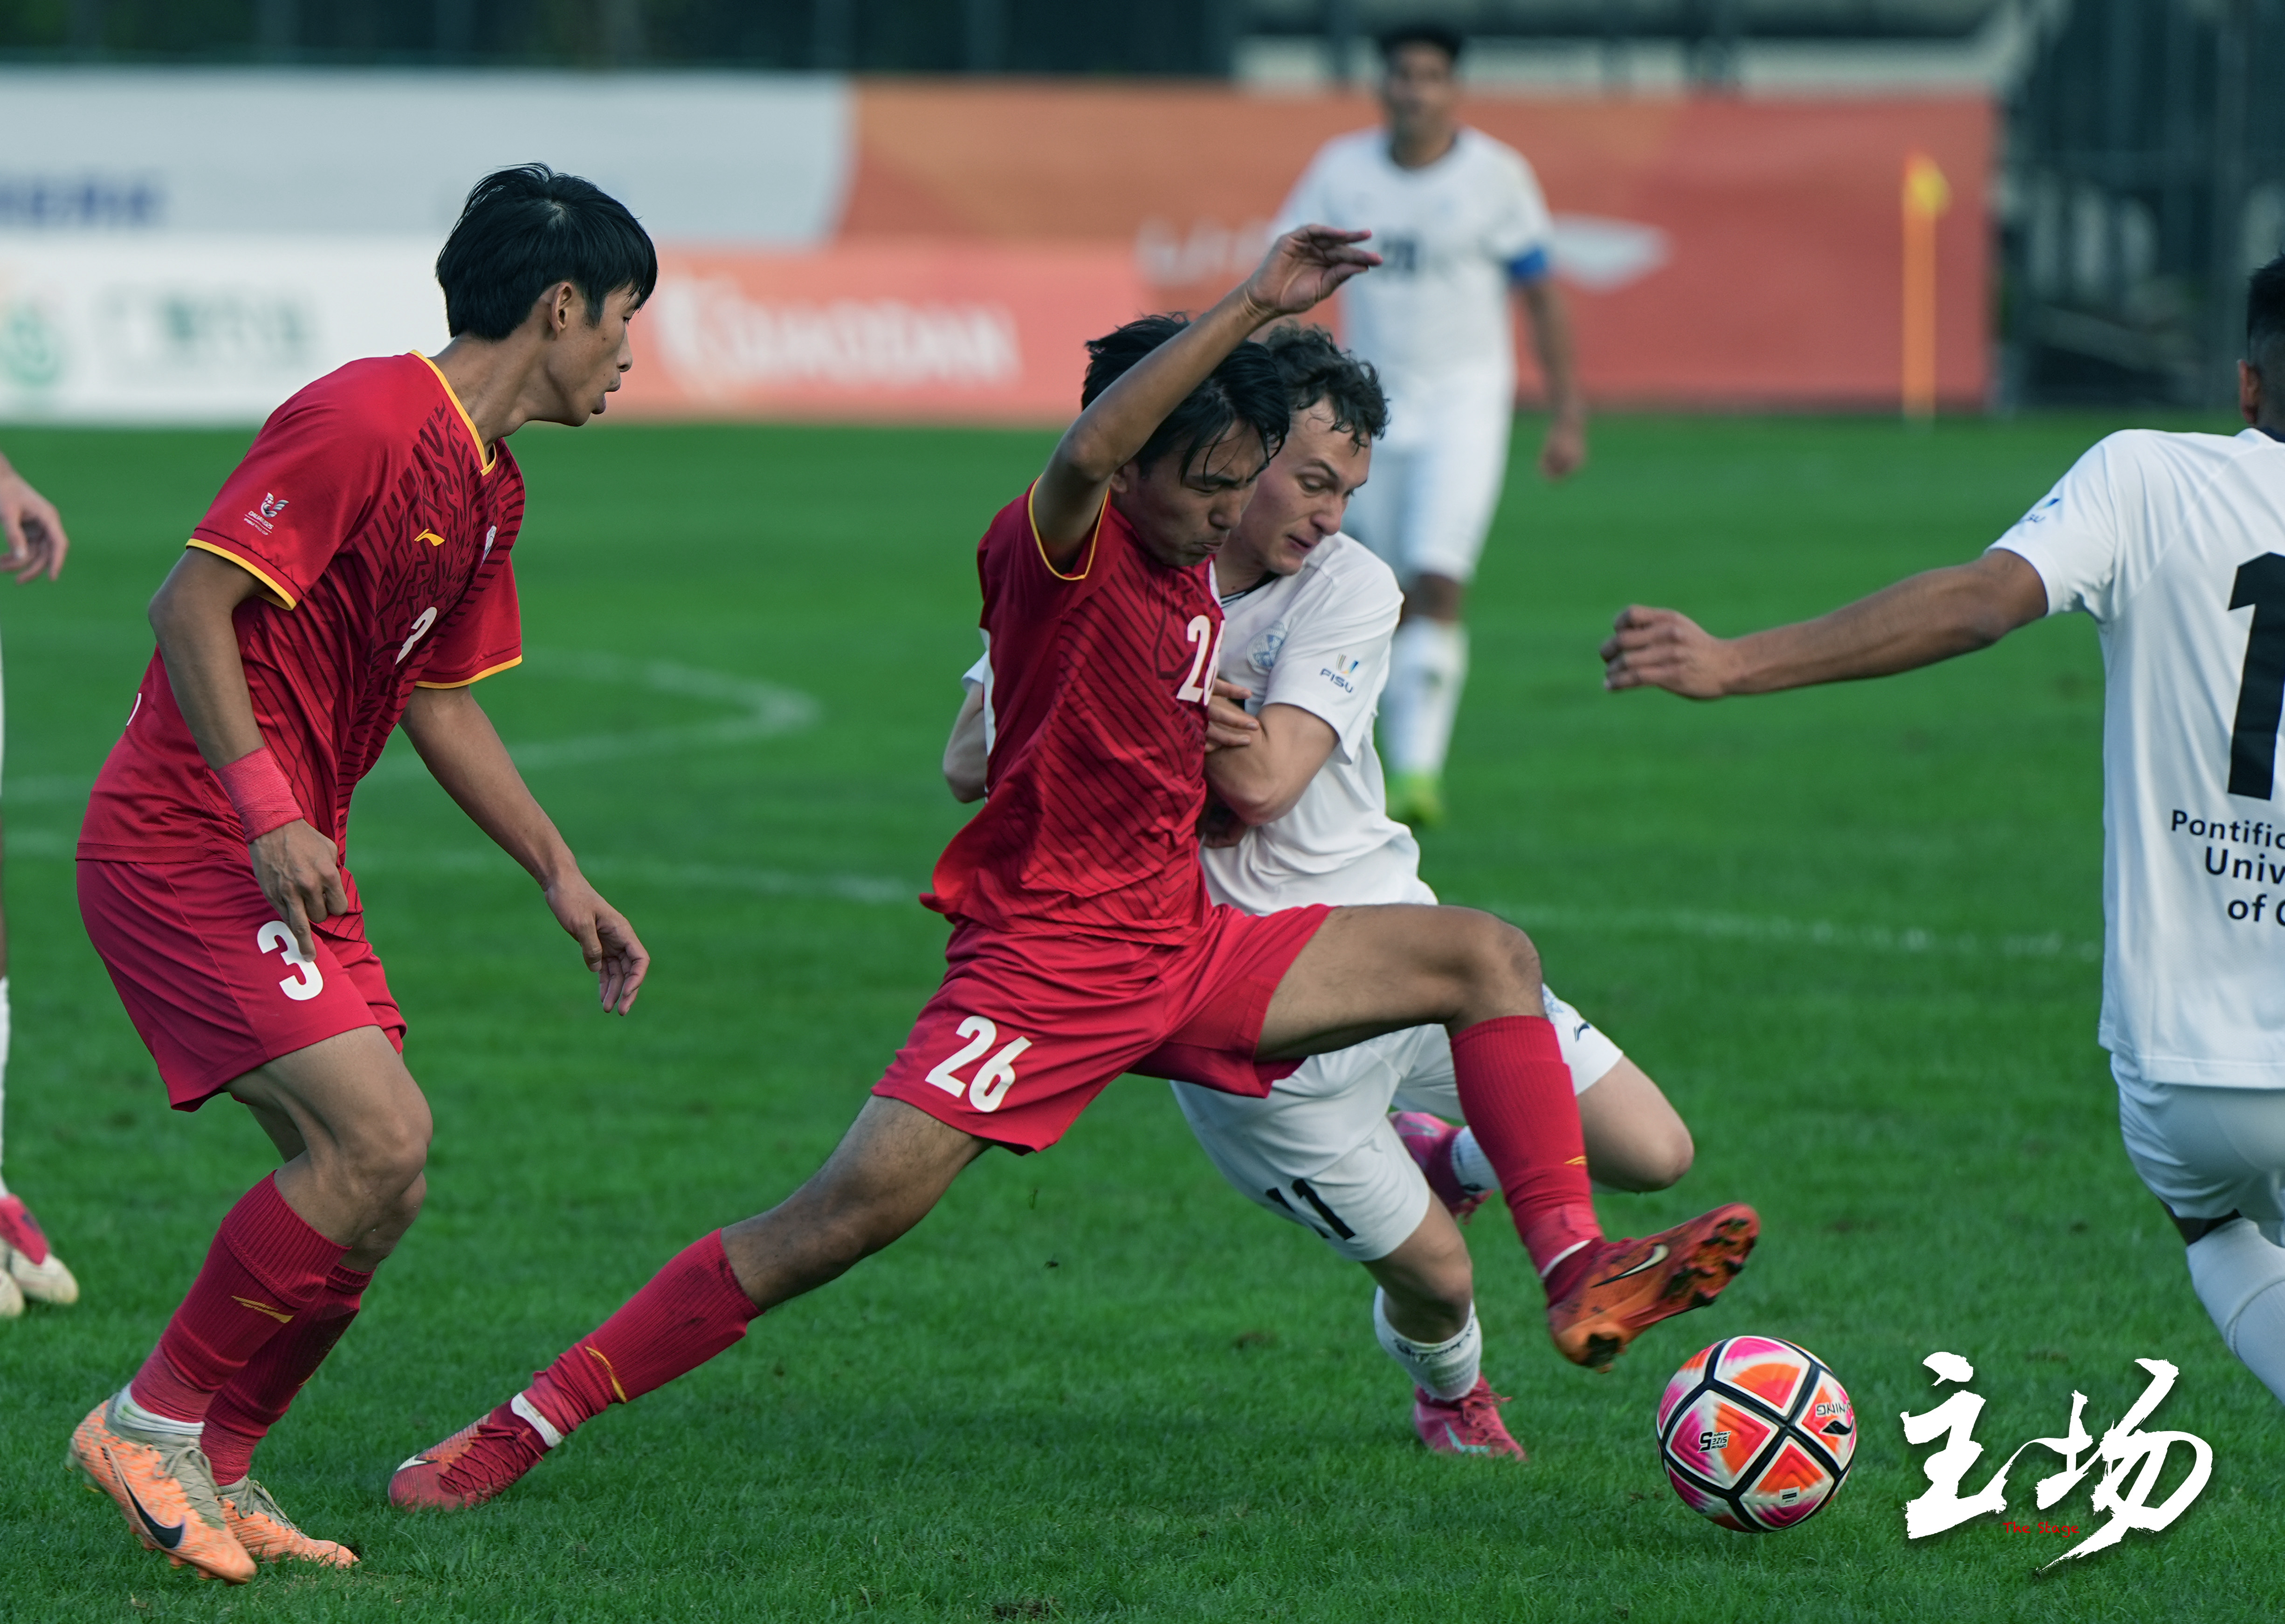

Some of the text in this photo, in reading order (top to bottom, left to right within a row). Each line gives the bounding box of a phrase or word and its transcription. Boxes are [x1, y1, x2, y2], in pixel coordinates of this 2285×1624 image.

[1320, 668, 1353, 693] FISU
[2205, 846, 2285, 884] Univ
[2228, 893, 2267, 922] of
[257, 920, 323, 1001] 3
[925, 1015, 1032, 1113] 26
[1265, 1178, 1356, 1241] 11
[1700, 1431, 1713, 1452] 5
